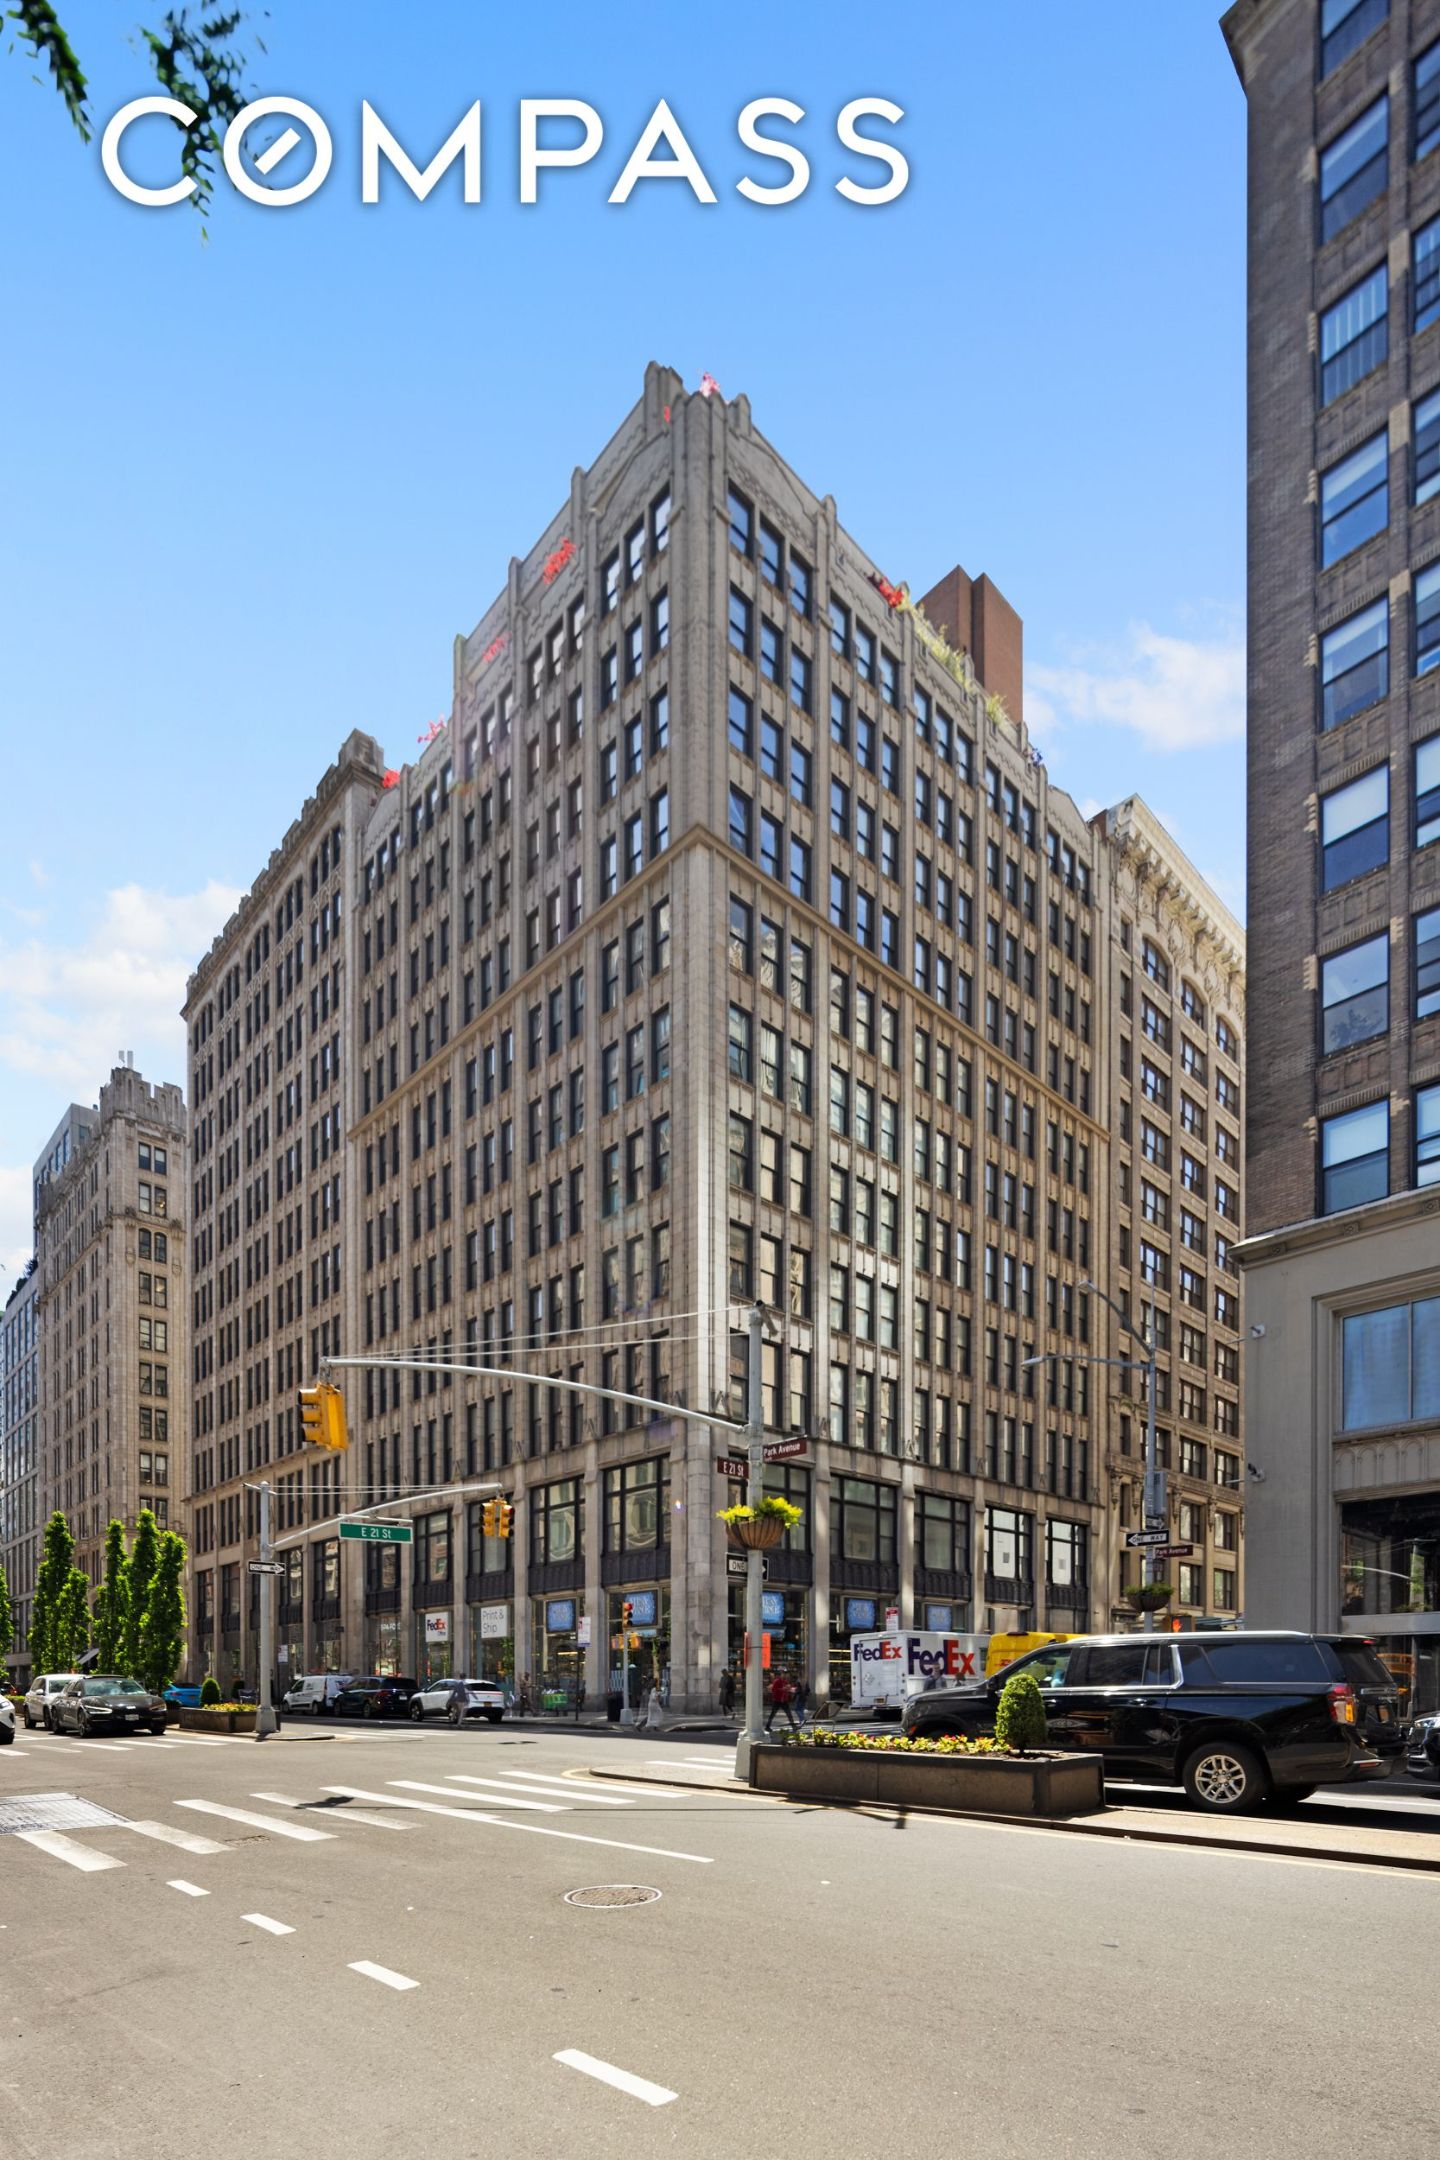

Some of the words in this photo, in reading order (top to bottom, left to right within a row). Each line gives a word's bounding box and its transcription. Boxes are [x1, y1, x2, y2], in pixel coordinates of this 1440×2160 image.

[763, 1446, 777, 1457] Park
[778, 1442, 801, 1455] Avenue
[723, 1461, 728, 1473] E
[729, 1462, 736, 1475] 21
[737, 1464, 744, 1476] St
[361, 1527, 367, 1537] E
[370, 1527, 379, 1538] 21
[382, 1529, 391, 1539] St
[732, 1562, 745, 1571] ONE
[483, 1610, 498, 1621] Print
[499, 1609, 504, 1620] &
[427, 1618, 446, 1631] FedEx
[483, 1622, 498, 1634] Ship
[853, 1640, 902, 1662] FedEx
[907, 1637, 975, 1676] FedEx
